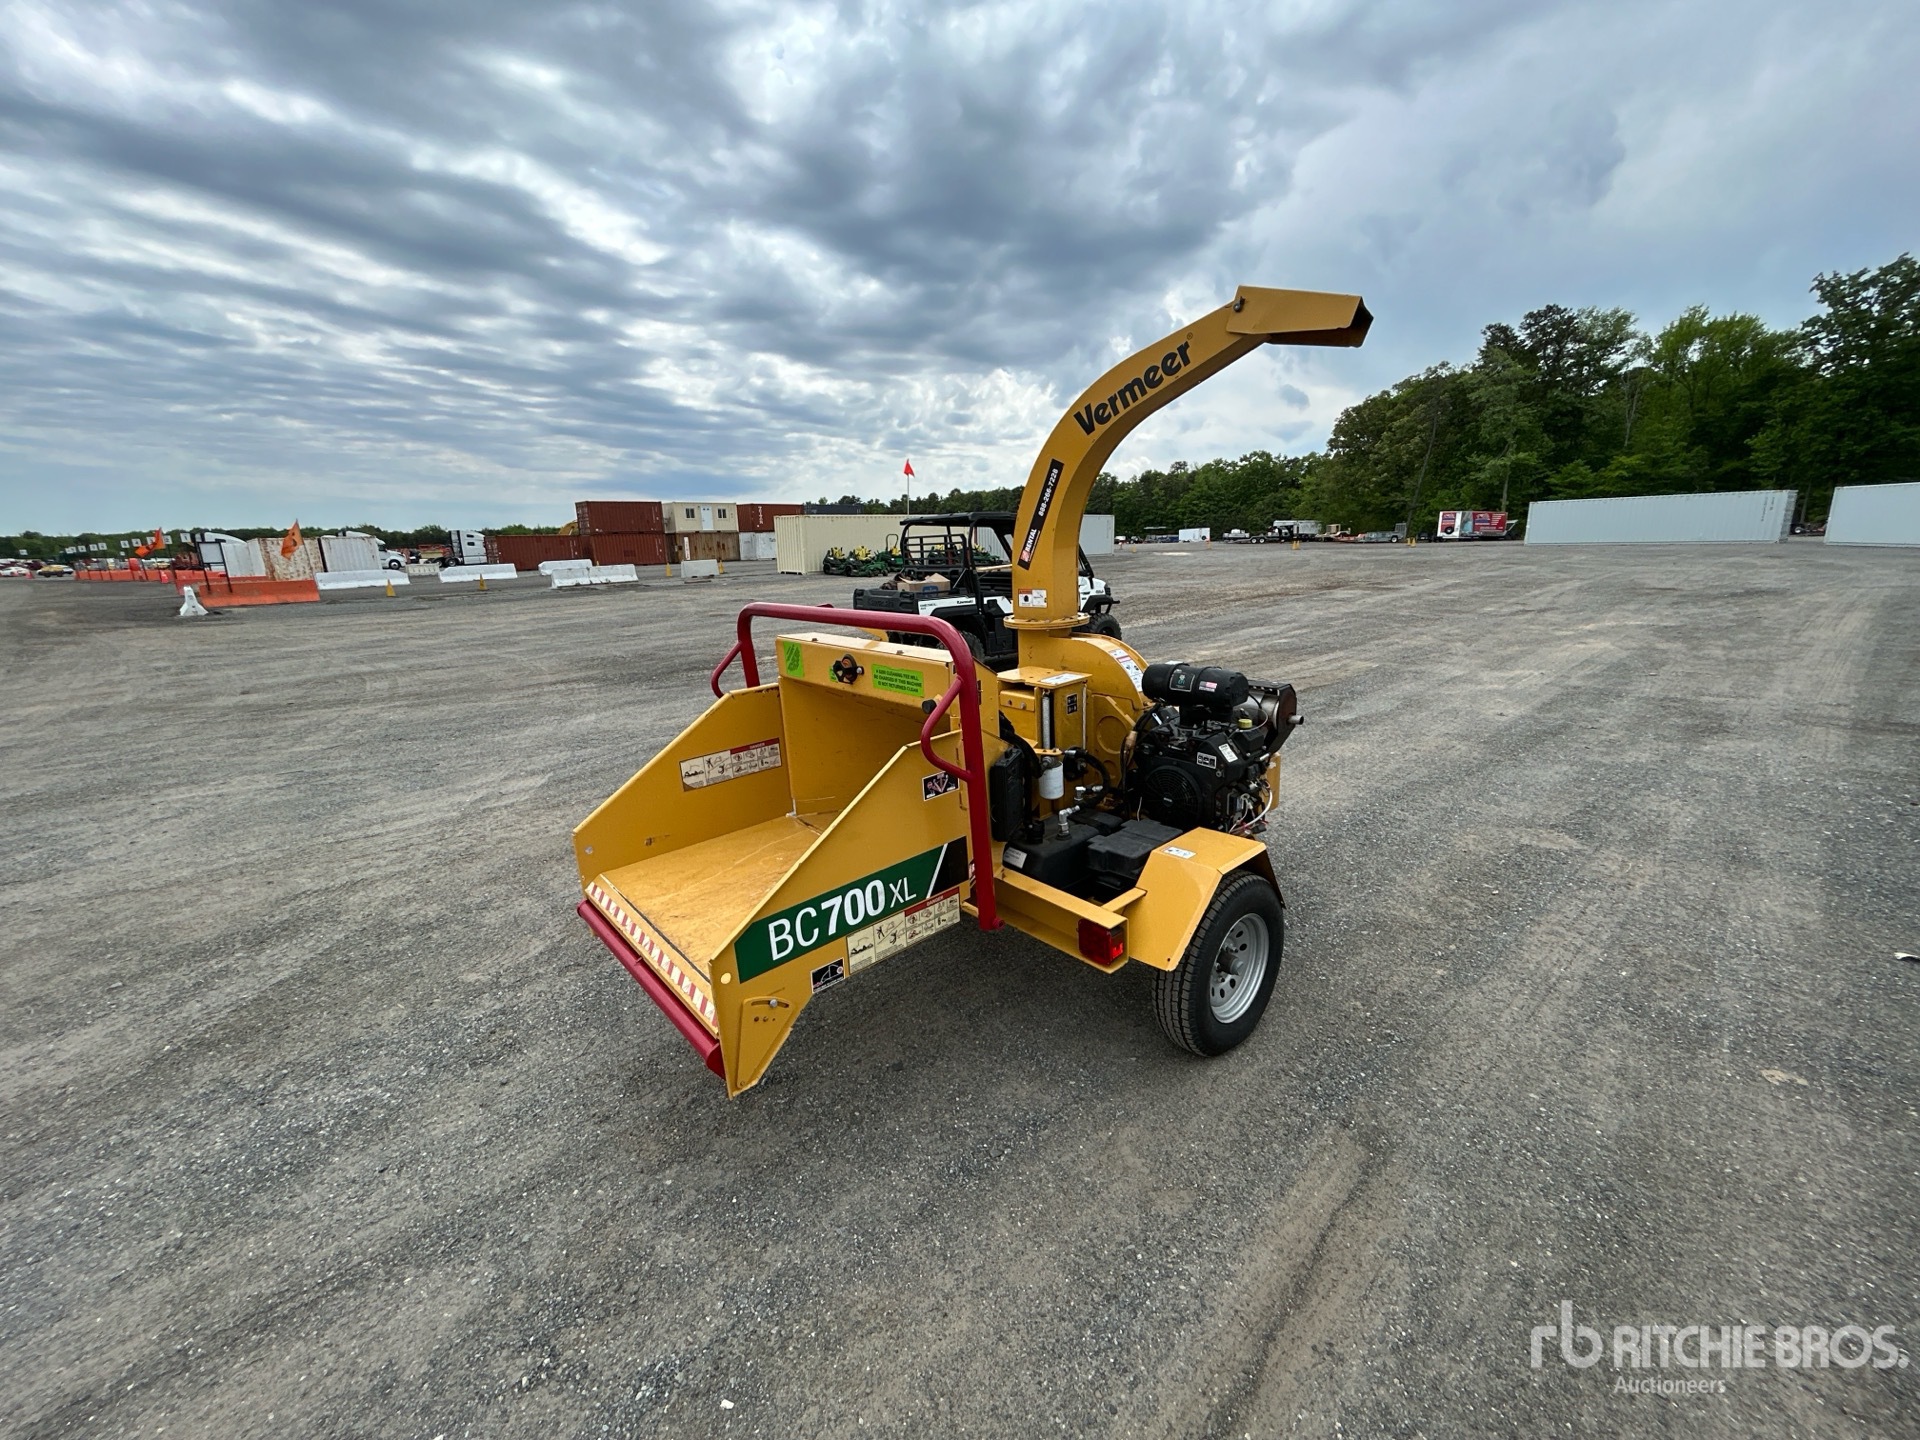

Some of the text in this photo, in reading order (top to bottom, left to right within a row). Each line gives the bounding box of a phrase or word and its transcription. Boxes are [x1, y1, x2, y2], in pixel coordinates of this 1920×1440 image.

[1073, 340, 1191, 436] Vermeer
[1025, 529, 1037, 552] RENTAL
[888, 877, 917, 909] XL
[926, 895, 944, 907] DANGER
